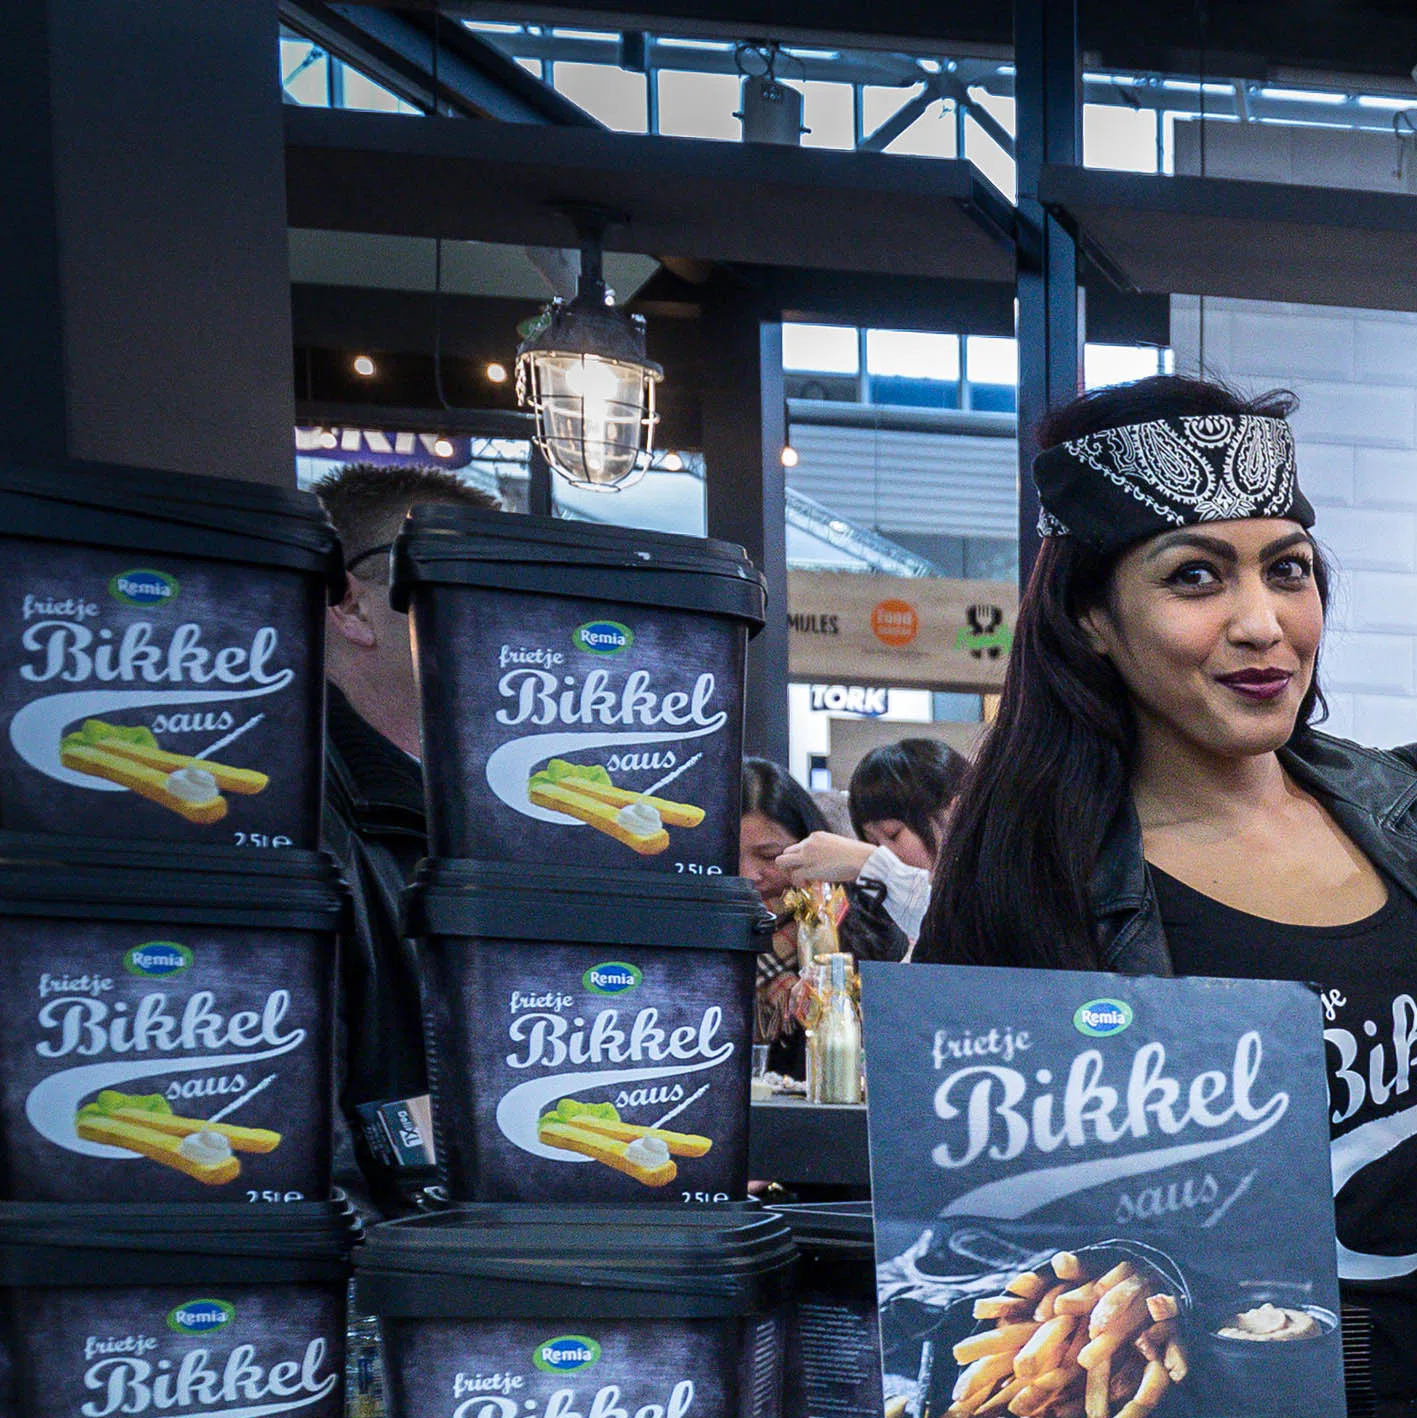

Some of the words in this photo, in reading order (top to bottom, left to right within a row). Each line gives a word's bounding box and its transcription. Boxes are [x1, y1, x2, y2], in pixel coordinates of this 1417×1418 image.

[581, 628, 627, 647] Remia
[20, 621, 294, 684] Bikkel
[499, 644, 565, 669] frietje
[496, 669, 727, 726] Bikkel
[811, 685, 887, 714] TORK
[152, 711, 235, 734] saus
[606, 751, 676, 773] saus
[590, 971, 635, 987] Remia
[510, 991, 574, 1013] frietje
[36, 989, 307, 1058] Bikkel
[1081, 1009, 1127, 1027] Remia
[506, 1006, 735, 1069] Bikkel
[932, 1028, 1033, 1070] frietje
[165, 1073, 248, 1100] saus
[615, 1083, 684, 1108] saus
[931, 1030, 1290, 1169] Bikkel
[1115, 1173, 1219, 1224] saus
[542, 1347, 593, 1366] Remia
[81, 1337, 338, 1418] Bikkel
[453, 1371, 525, 1399] frietje
